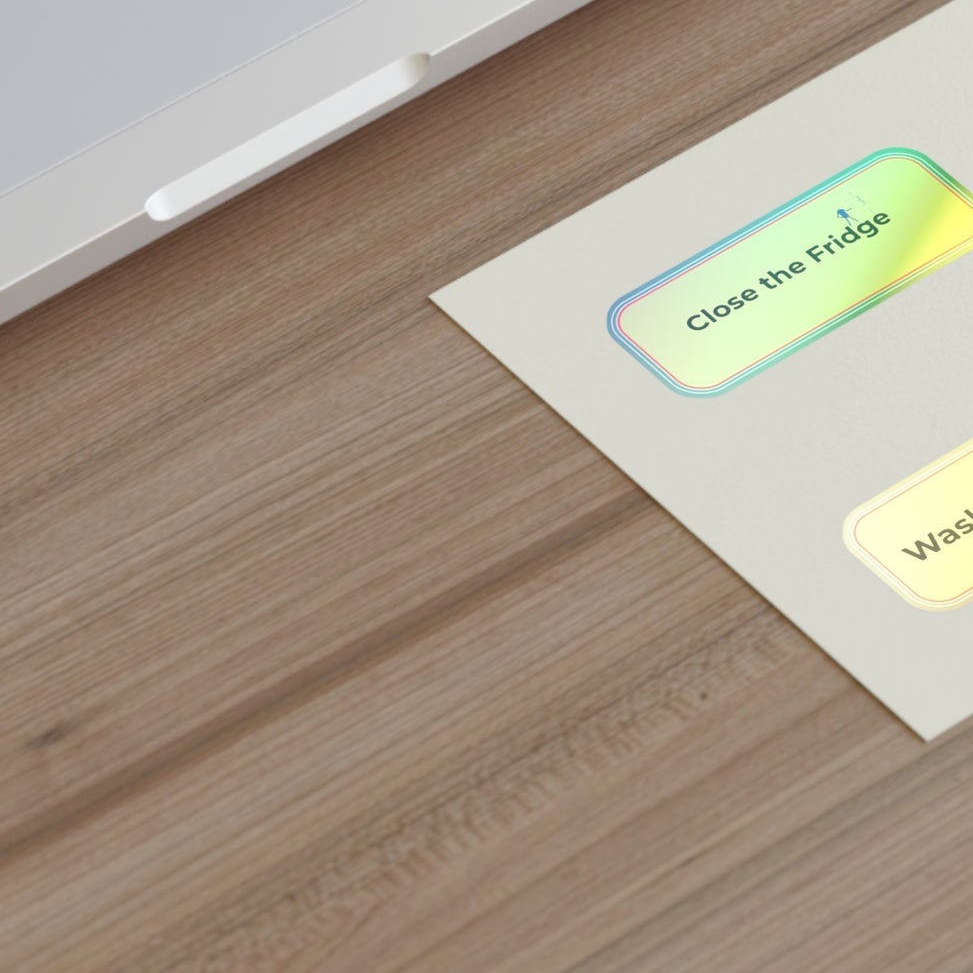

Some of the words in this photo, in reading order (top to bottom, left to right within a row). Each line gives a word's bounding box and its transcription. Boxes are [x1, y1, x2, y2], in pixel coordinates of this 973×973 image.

[686, 287, 759, 332] Close
[758, 260, 807, 290] the
[805, 211, 891, 263] Fridge
